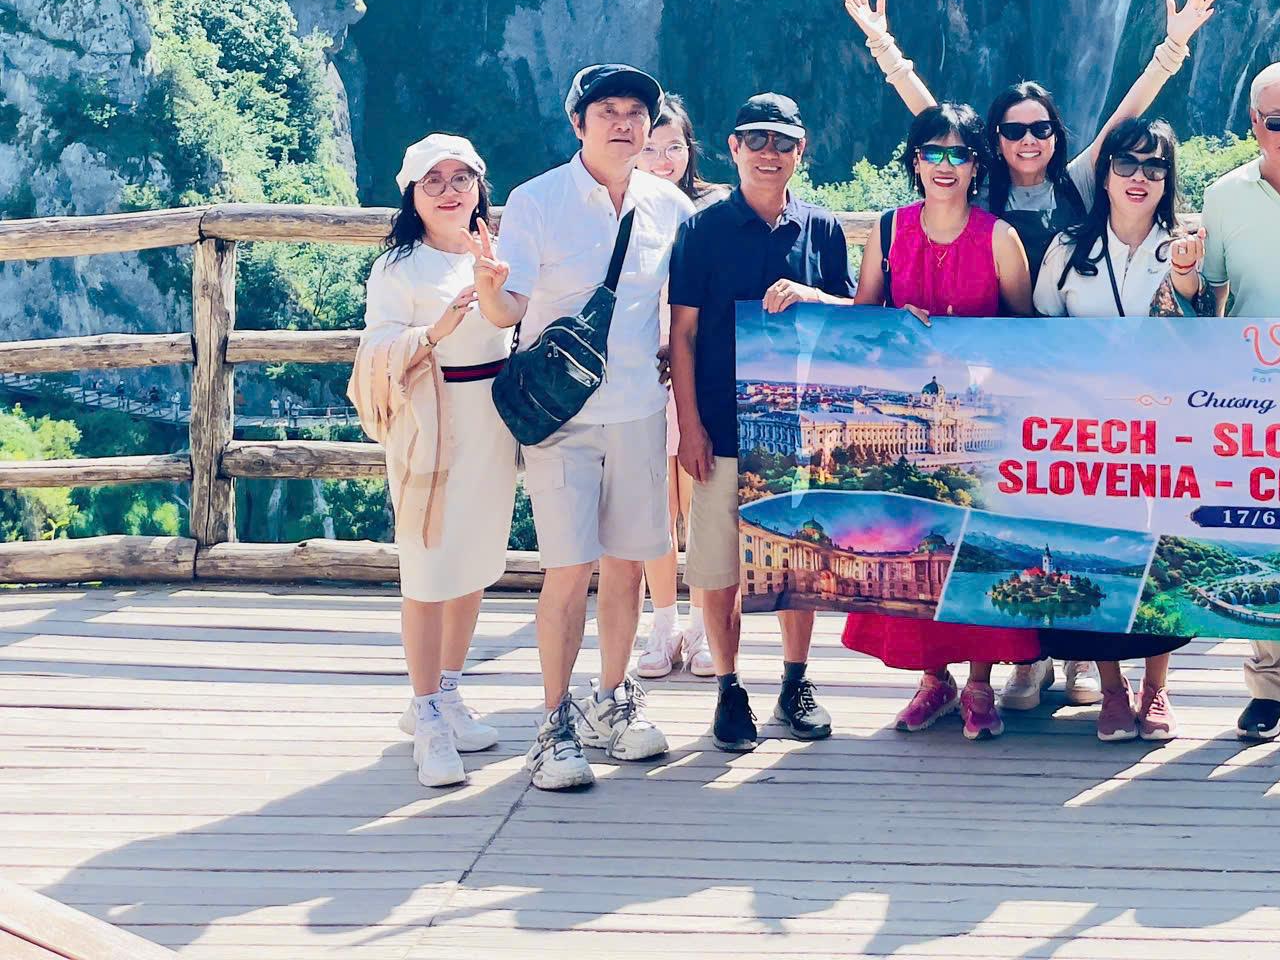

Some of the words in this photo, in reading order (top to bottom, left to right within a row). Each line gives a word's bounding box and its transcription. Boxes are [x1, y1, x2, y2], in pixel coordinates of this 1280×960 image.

[1251, 375, 1272, 384] For
[1187, 390, 1277, 415] Chương
[1022, 416, 1157, 454] CZECH
[997, 459, 1201, 498] SLOVENIA
[1222, 509, 1276, 526] 17/6
